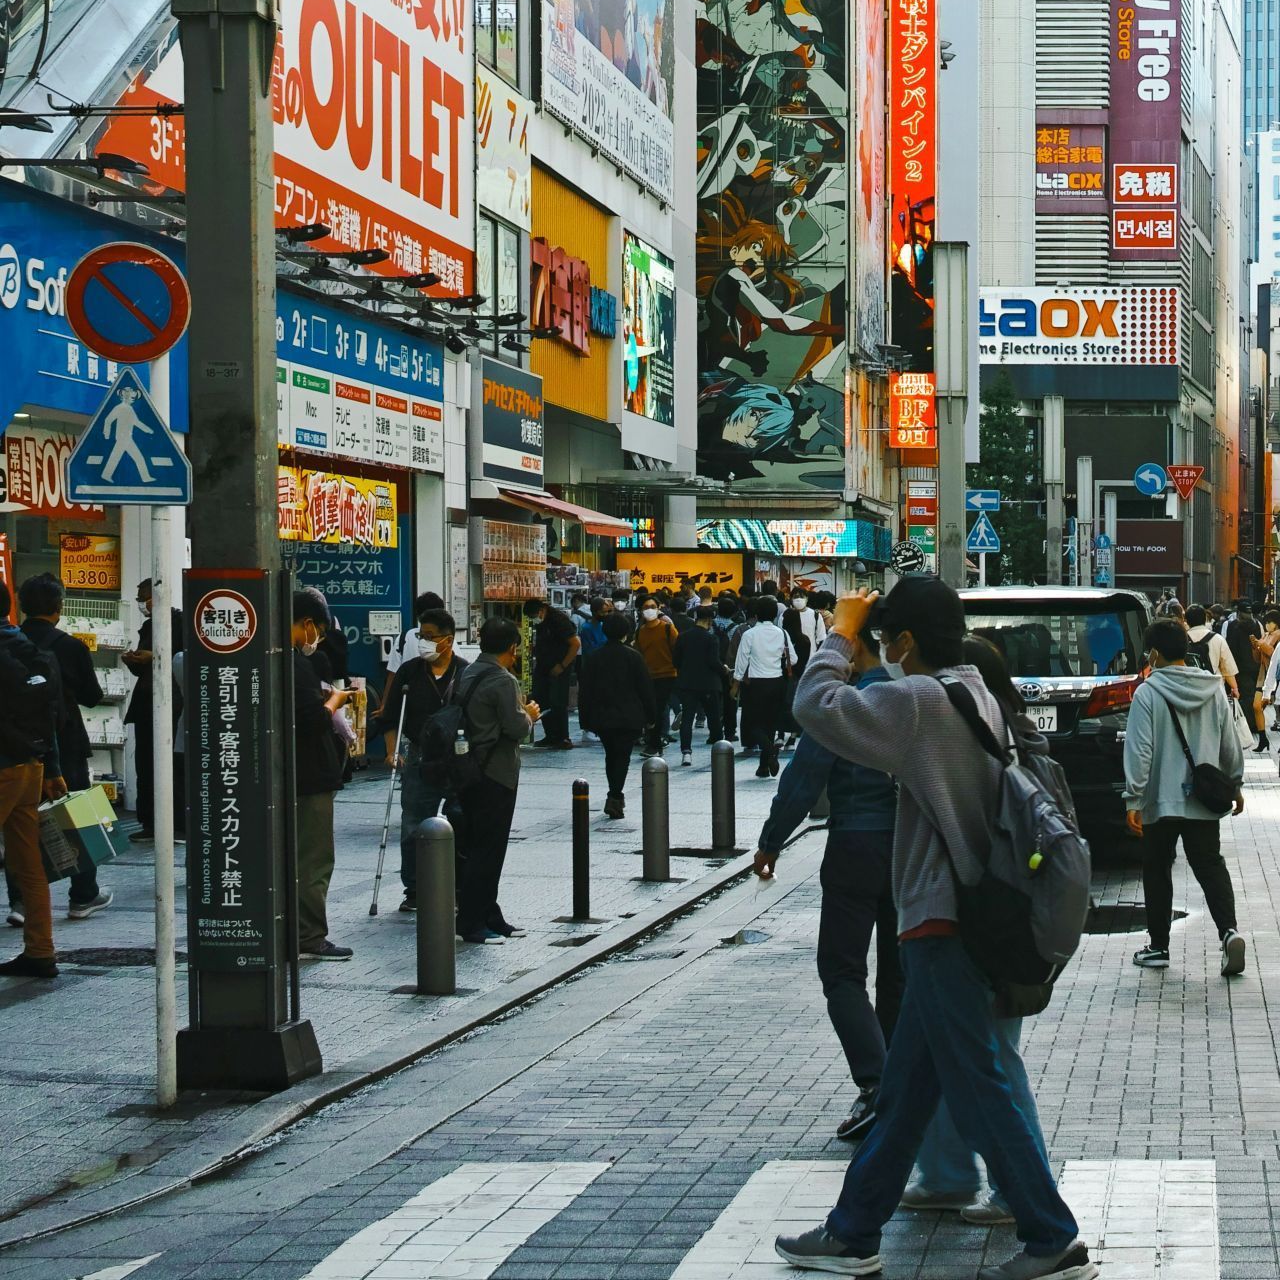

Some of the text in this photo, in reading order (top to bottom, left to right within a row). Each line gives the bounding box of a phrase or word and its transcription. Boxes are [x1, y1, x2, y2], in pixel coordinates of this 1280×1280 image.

[1118, 7, 1134, 60] Store
[1137, 19, 1177, 102] Free
[1036, 128, 1070, 145] 本店
[1036, 147, 1103, 164] 総合家電
[1036, 172, 1103, 190] Laox
[1118, 171, 1171, 197] 免税
[1117, 219, 1173, 240] 면세점
[293, 310, 424, 382] 2F 3F 4F 5F
[1003, 342, 1077, 355] Electronics
[1082, 342, 1120, 355] Store
[482, 378, 542, 419] アクセスチケット
[305, 400, 317, 419] Mac
[335, 406, 351, 427] テレビ
[1178, 478, 1194, 486] STOP
[203, 609, 247, 624] 客引き
[200, 626, 250, 637] Solicitation
[200, 666, 209, 681] No
[251, 667, 260, 705] 千代田区内
[201, 753, 211, 769] No
[218, 666, 243, 907] 客引き・客待ち・スカウト禁止
[203, 839, 212, 855] No
